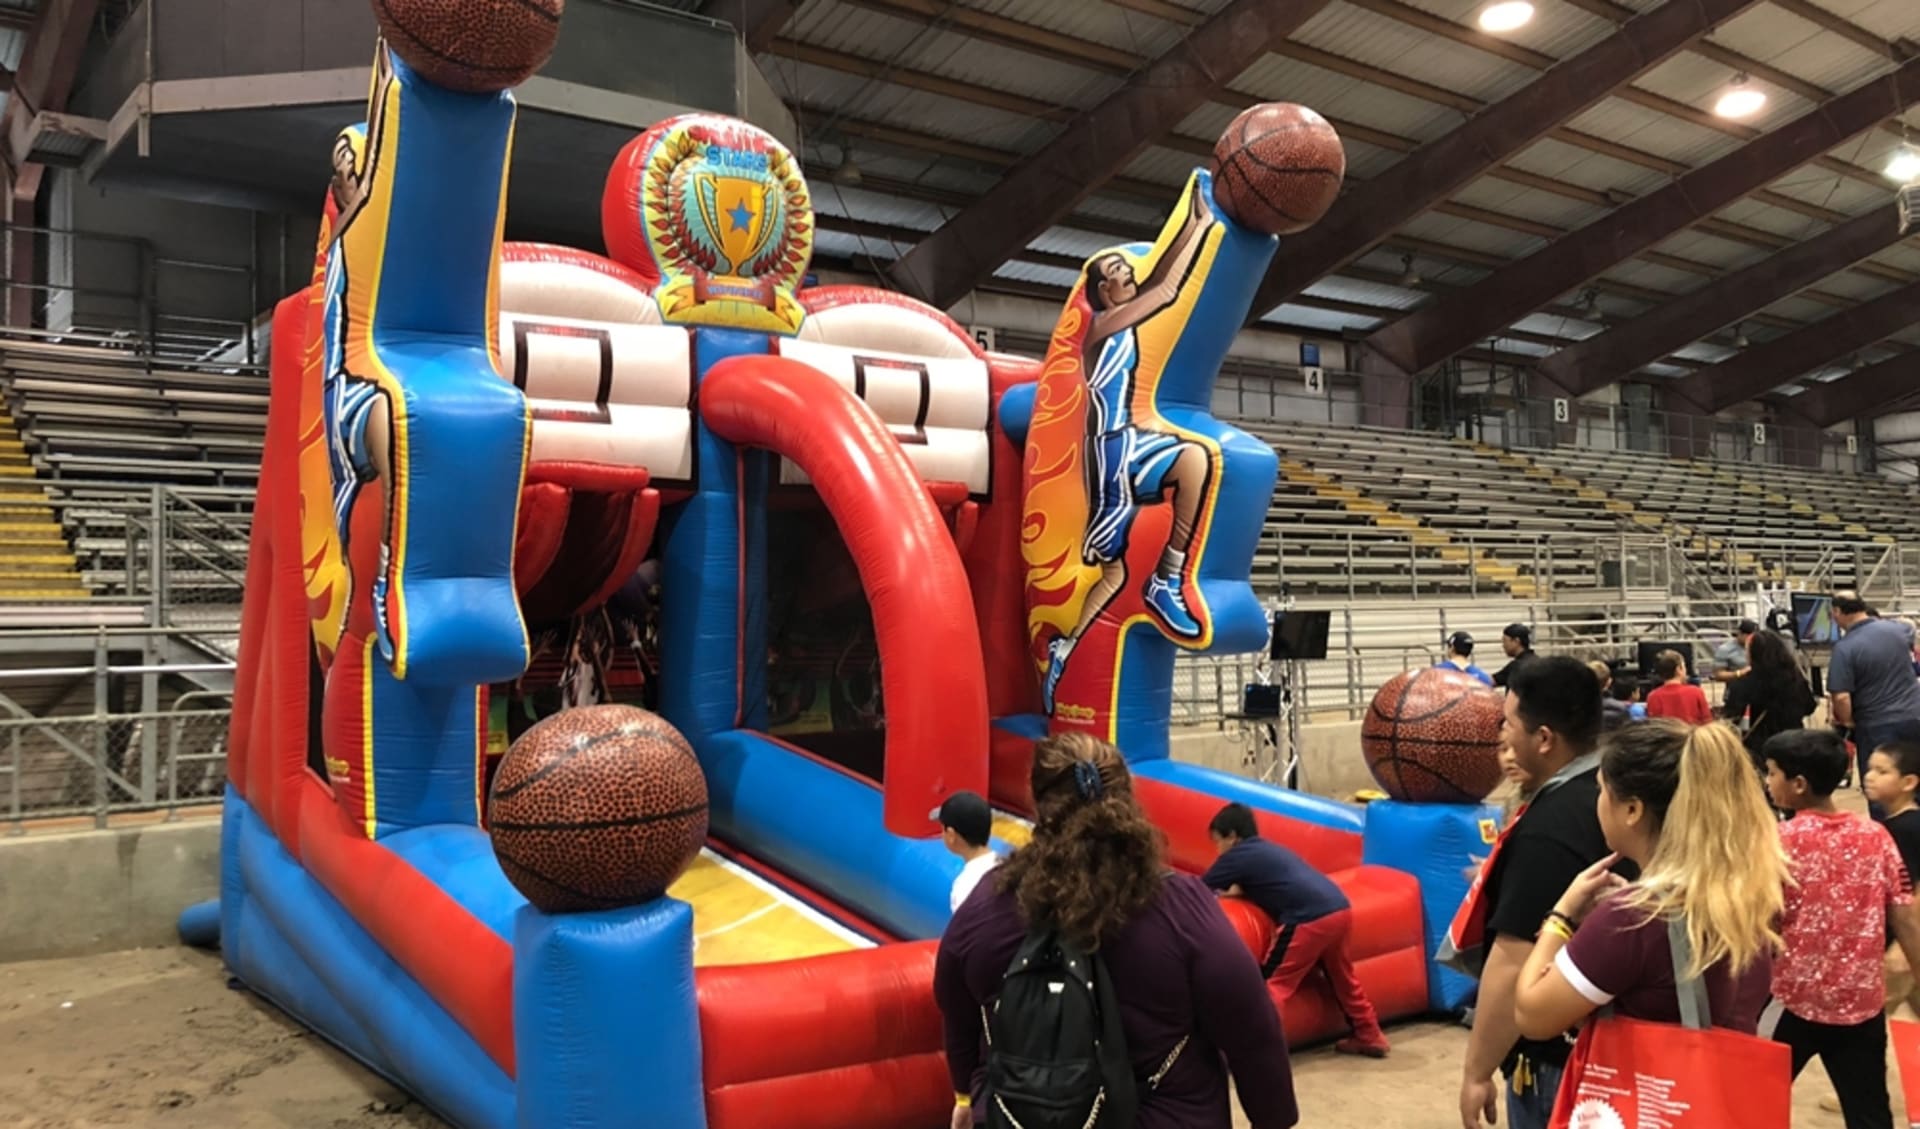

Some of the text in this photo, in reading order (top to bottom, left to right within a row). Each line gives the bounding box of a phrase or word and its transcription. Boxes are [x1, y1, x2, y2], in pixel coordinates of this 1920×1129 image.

[706, 145, 768, 173] STARS
[976, 331, 988, 351] 5
[1309, 370, 1319, 391] 4
[1556, 401, 1566, 420] 3
[1756, 425, 1764, 441] 2
